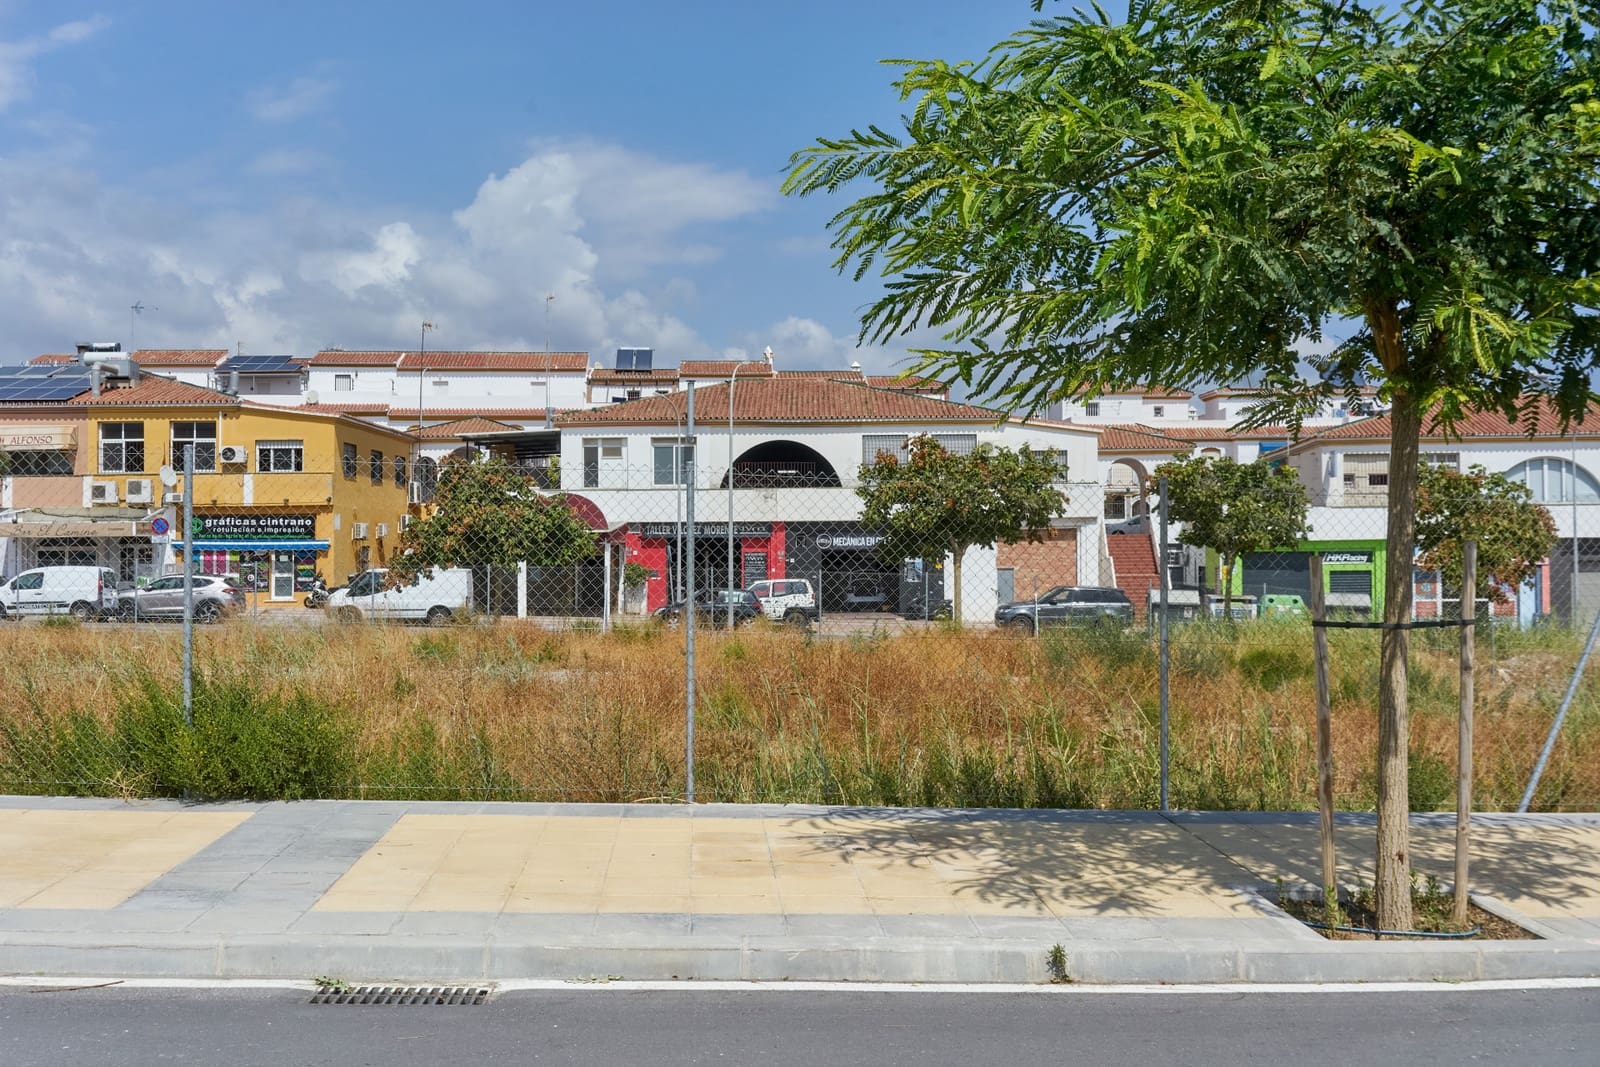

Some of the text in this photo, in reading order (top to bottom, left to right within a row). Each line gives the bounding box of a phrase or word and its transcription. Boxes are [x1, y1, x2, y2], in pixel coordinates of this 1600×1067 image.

[11, 436, 53, 444] ALFONSO
[205, 517, 312, 527] gráficas cintrano
[264, 526, 305, 535] impresión
[647, 525, 670, 535] TALLER
[704, 525, 739, 535] MORENE
